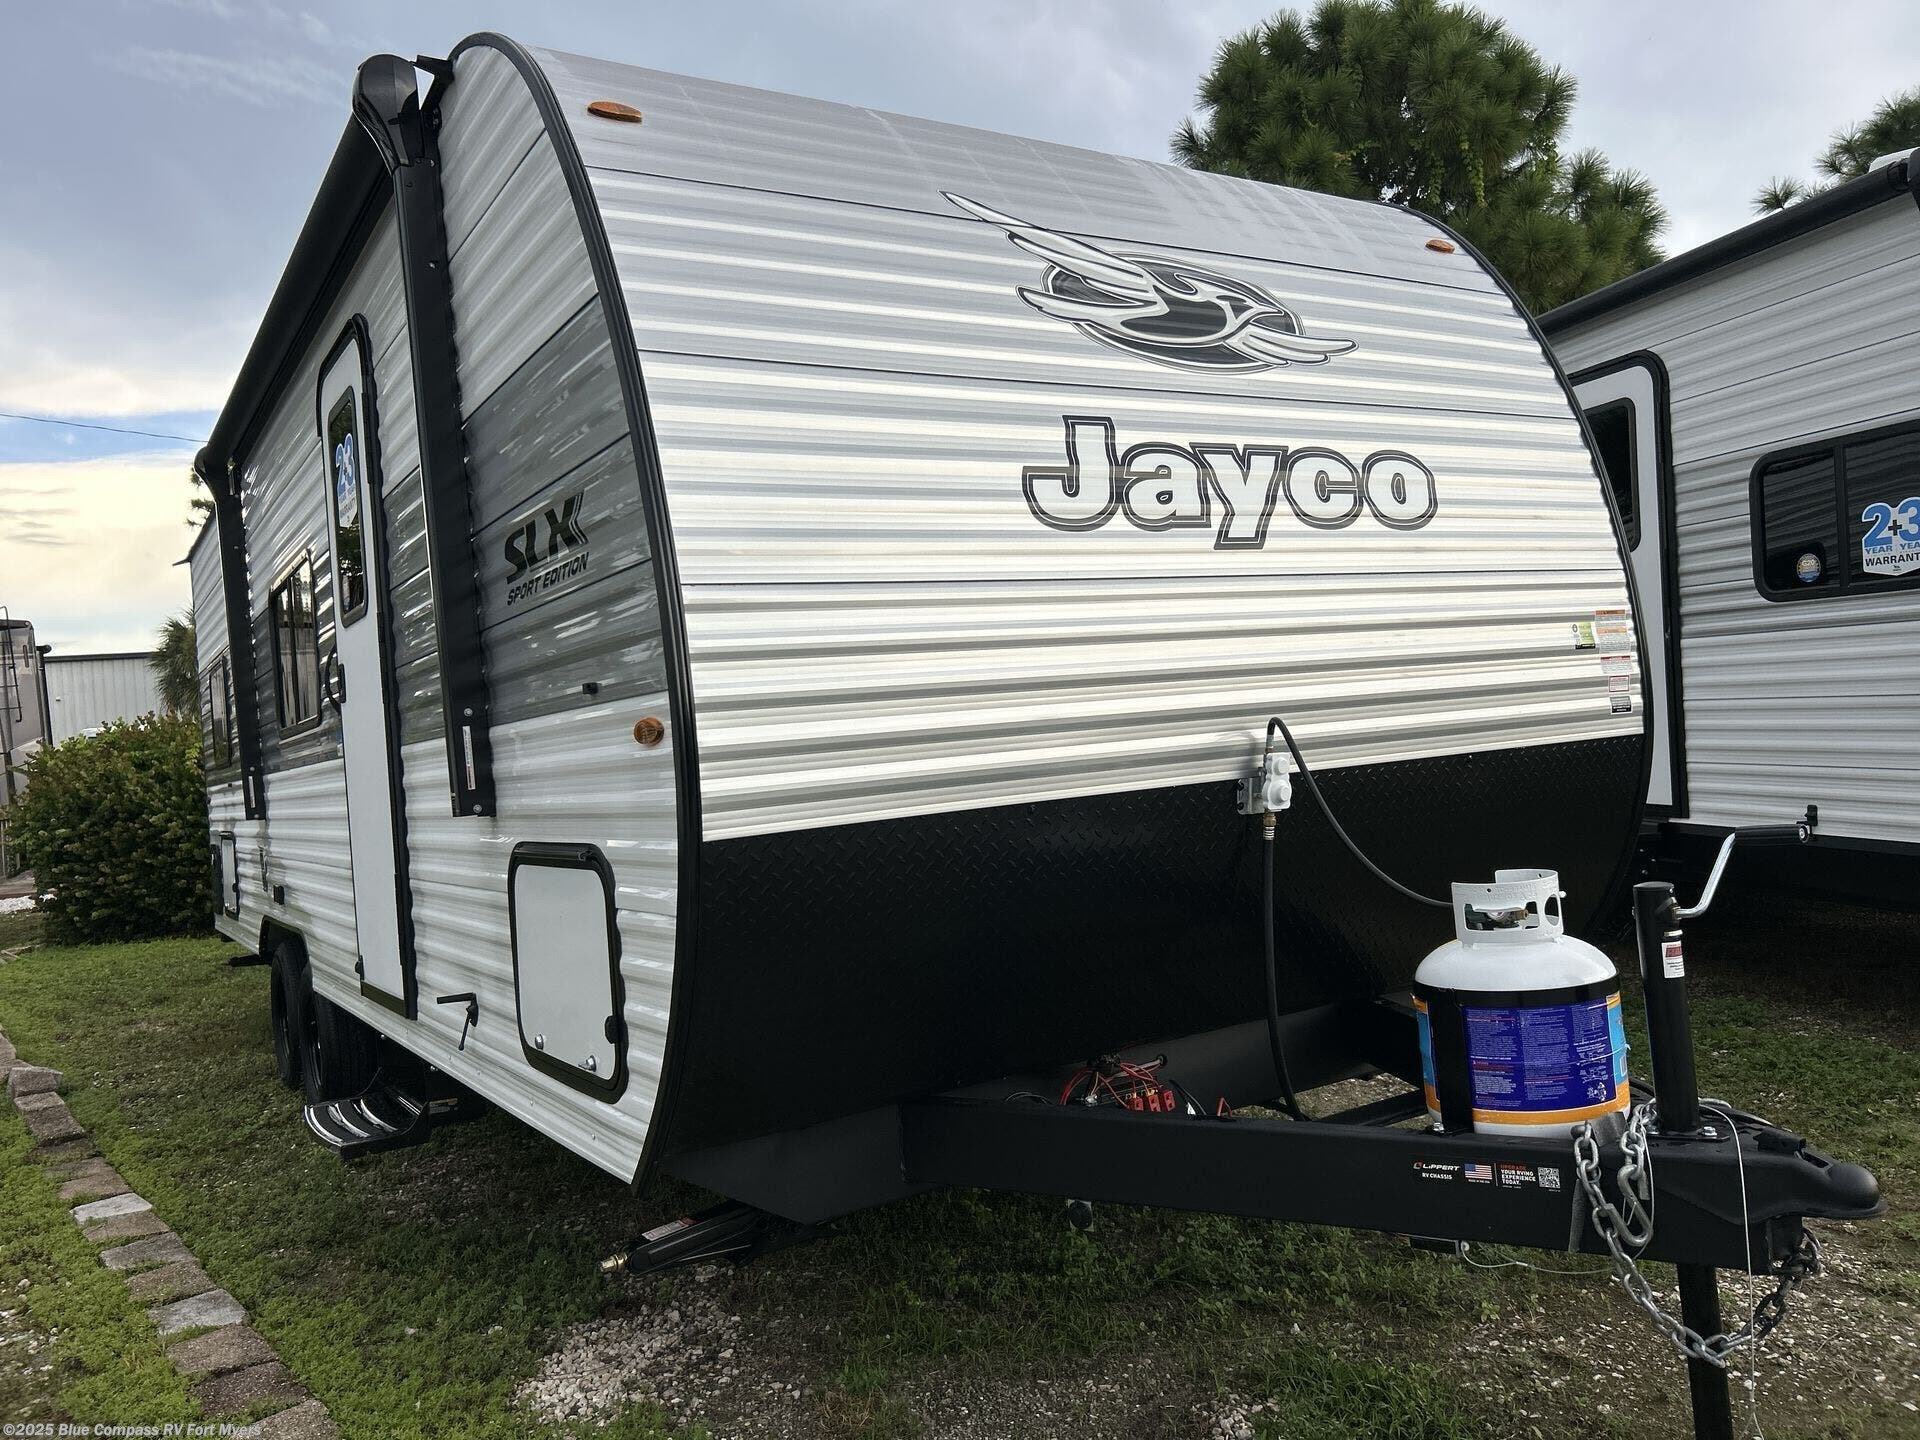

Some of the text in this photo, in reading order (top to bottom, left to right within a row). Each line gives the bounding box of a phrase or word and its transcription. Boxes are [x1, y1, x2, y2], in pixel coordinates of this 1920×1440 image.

[1022, 415, 1438, 550] Jayco
[505, 492, 590, 584] SLX
[1865, 541, 1920, 555] YEAR YEA
[1865, 552, 1920, 567] WARRANT
[507, 552, 590, 606] SPORT EDITION
[1429, 1172, 1453, 1180] CHASSIS
[1501, 1174, 1536, 1182] EXPERIENCE
